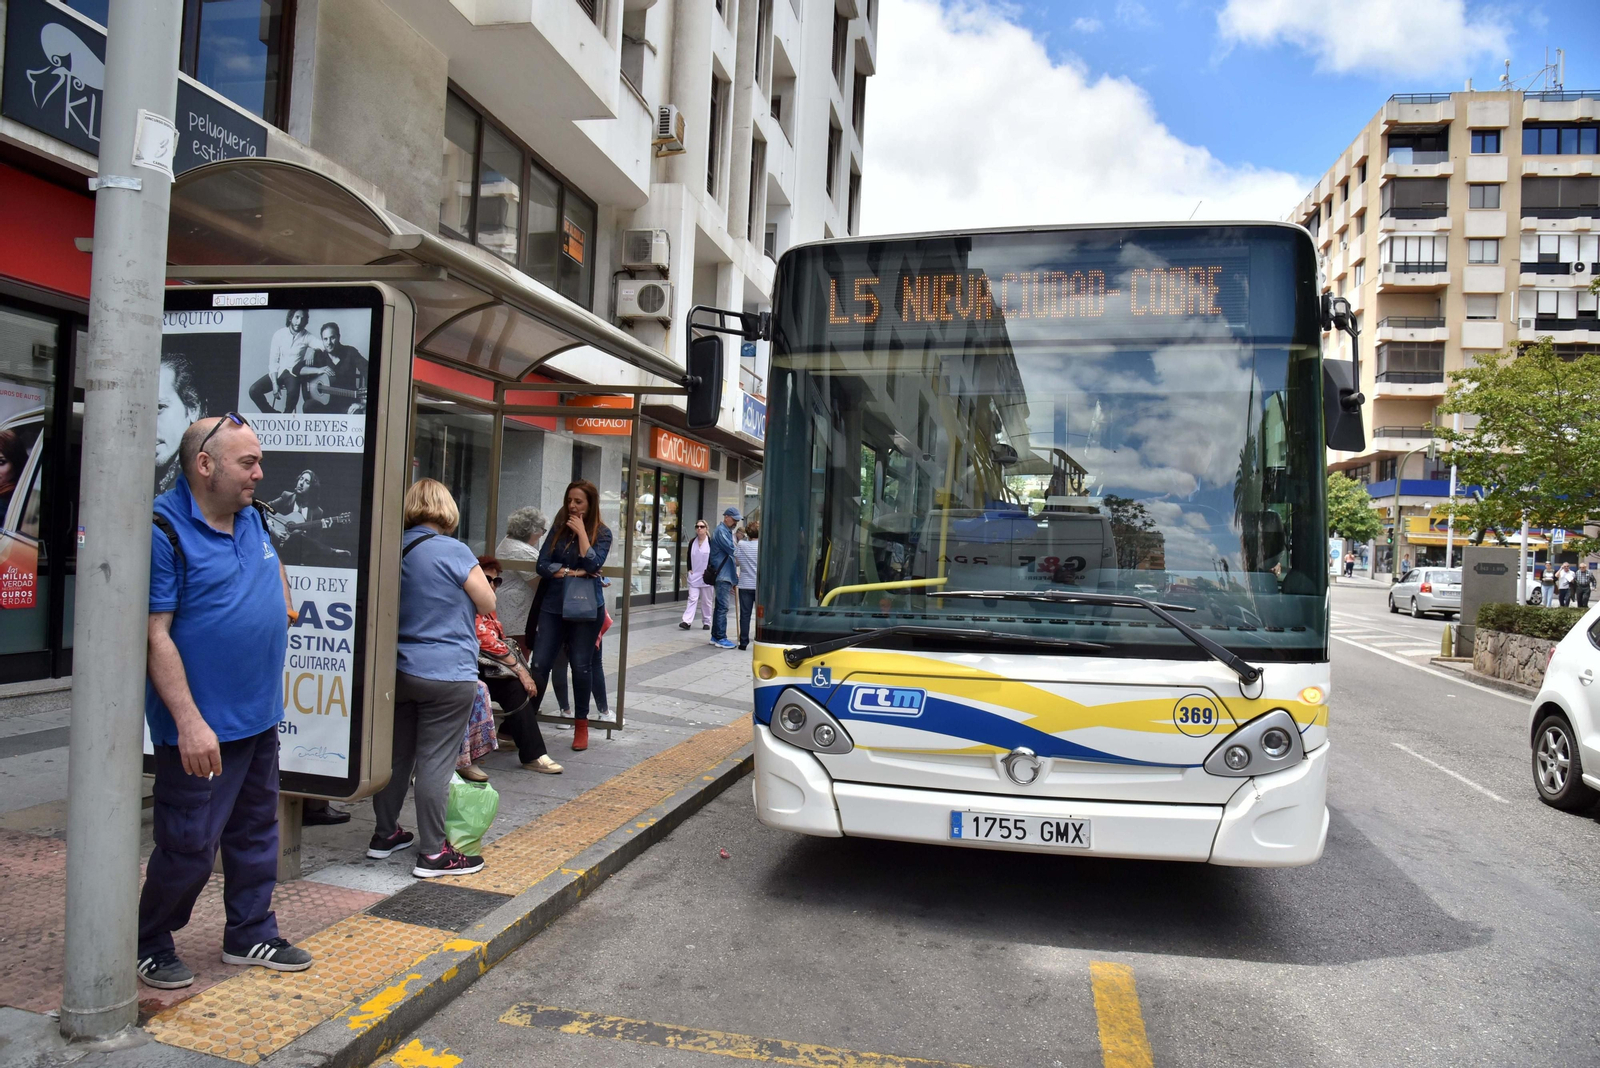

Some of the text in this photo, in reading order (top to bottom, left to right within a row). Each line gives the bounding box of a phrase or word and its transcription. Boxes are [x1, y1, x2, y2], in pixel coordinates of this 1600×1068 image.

[829, 278, 880, 324] L5
[902, 274, 992, 322] NUEVA
[1130, 265, 1222, 316] COBRE
[24, 393, 42, 401] AUTOS
[305, 420, 348, 433] REYES
[576, 417, 628, 428] CATCHALOT
[285, 435, 312, 446] DEL
[315, 435, 365, 448] MORAO
[661, 432, 707, 469] CATCHALOT
[3, 580, 33, 588] VERDAD
[316, 577, 349, 593] REY
[294, 600, 353, 632] AS
[289, 654, 347, 673] GUITARRA
[853, 687, 922, 714] ctm
[1179, 706, 1213, 725] 369
[278, 721, 298, 735] 5h
[972, 816, 1027, 840] 1755
[1040, 821, 1084, 844] GMX
